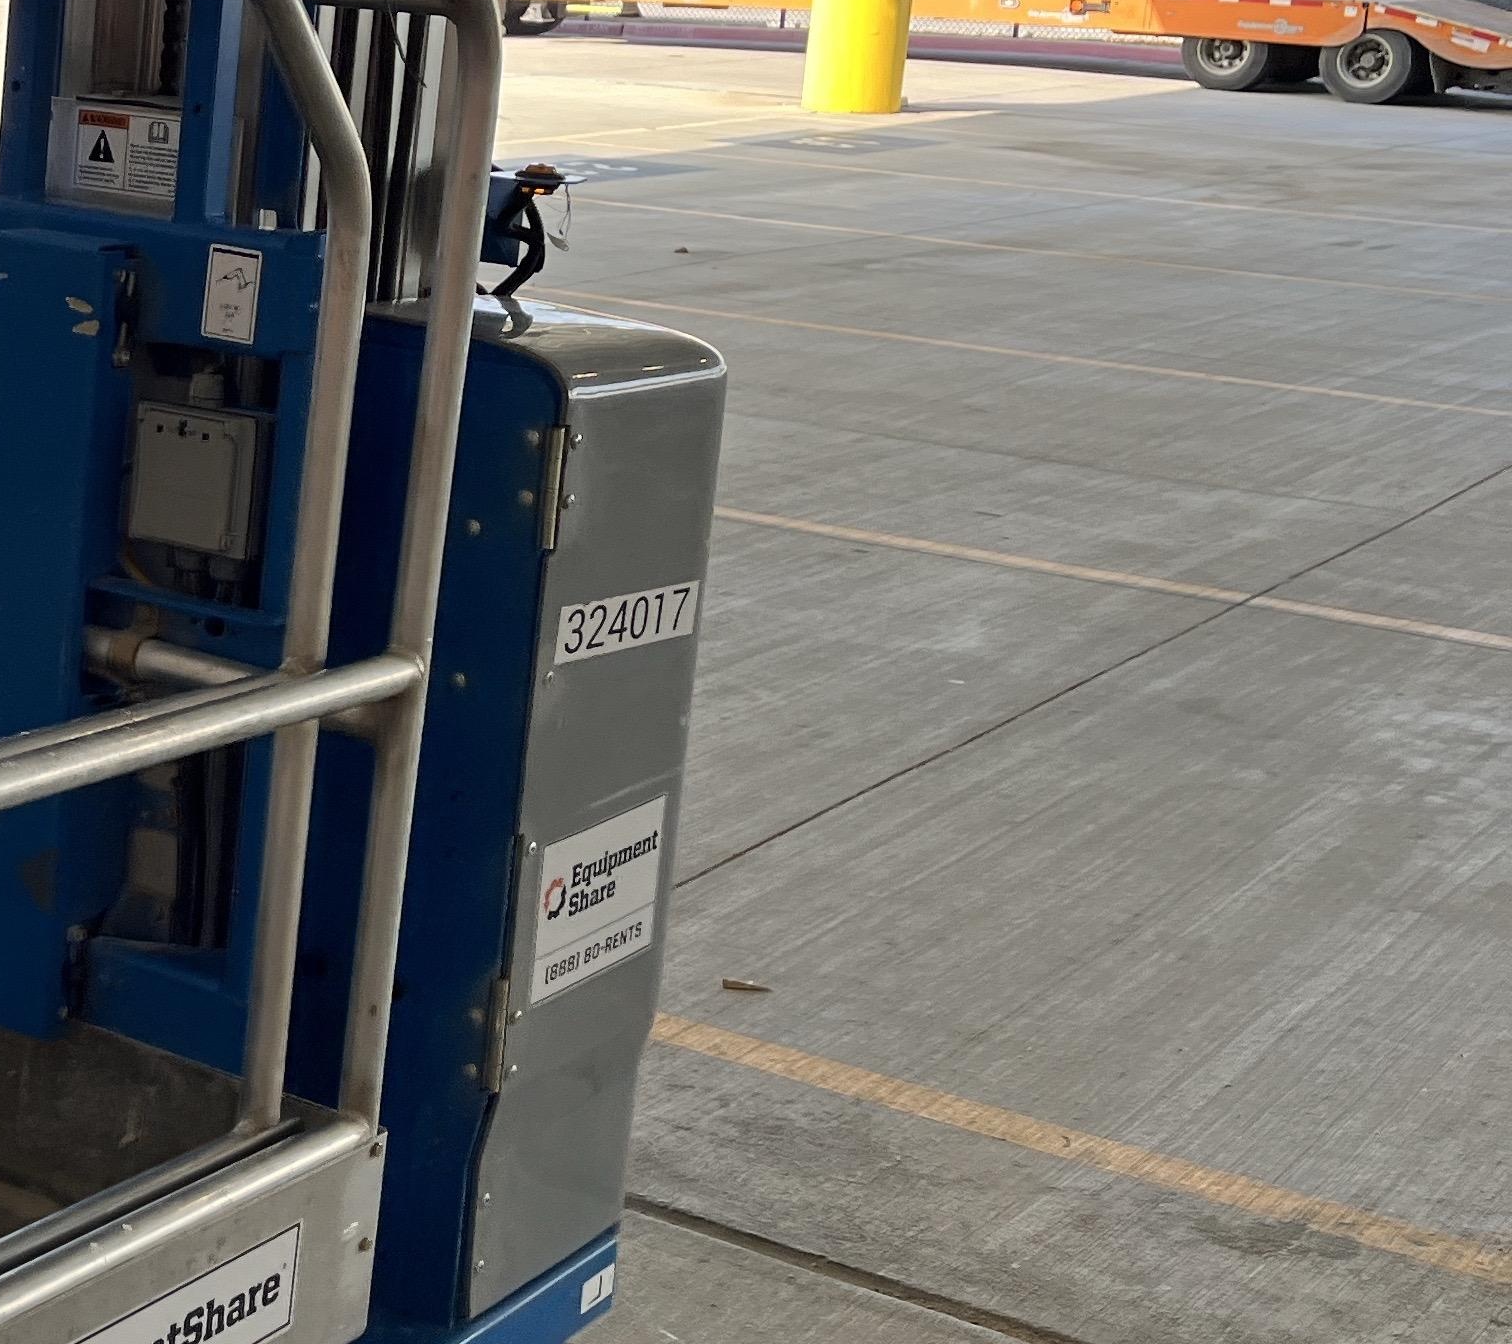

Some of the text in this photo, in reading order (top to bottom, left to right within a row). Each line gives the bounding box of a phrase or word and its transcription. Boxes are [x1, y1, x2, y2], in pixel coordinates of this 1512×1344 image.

[563, 586, 691, 655] 324017
[570, 829, 659, 889] Equipment
[567, 879, 617, 918] Share
